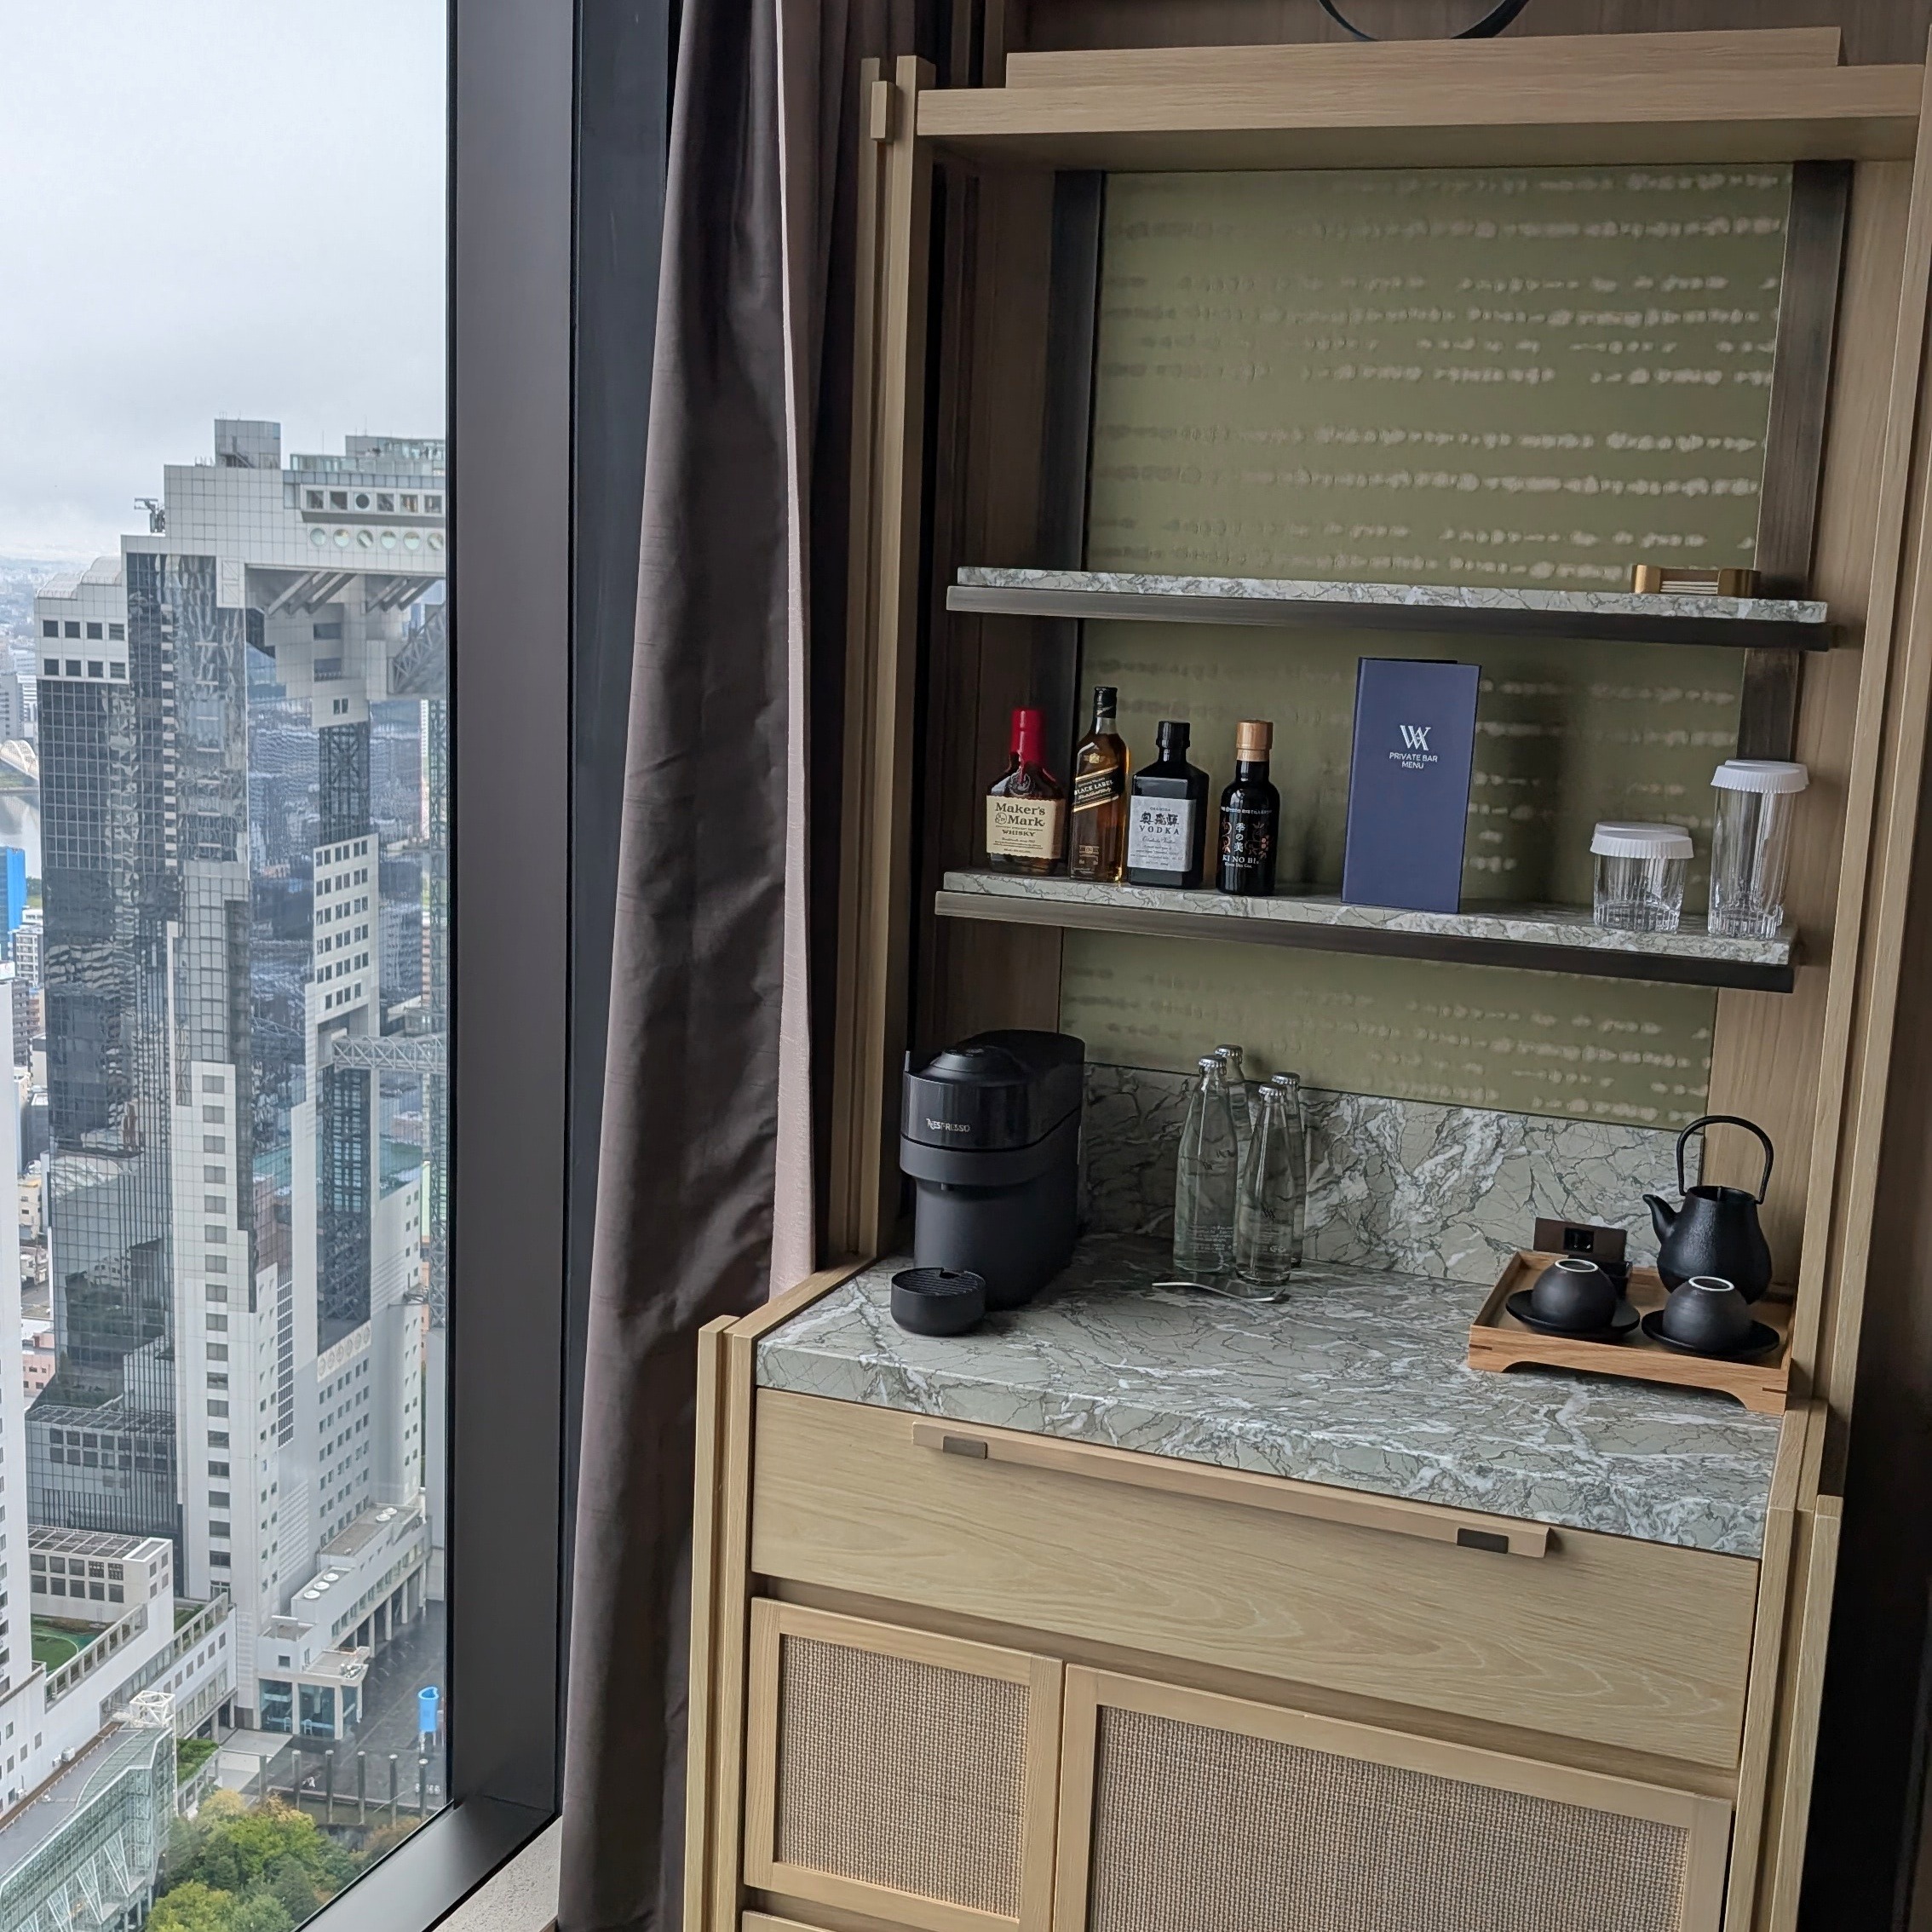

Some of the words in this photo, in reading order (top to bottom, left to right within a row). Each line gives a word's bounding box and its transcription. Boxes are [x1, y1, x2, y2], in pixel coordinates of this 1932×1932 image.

[1389, 752, 1421, 762] PRIVATE
[1401, 761, 1424, 769] MENU
[1094, 779, 1113, 789] LABEL
[995, 802, 1046, 815] Maker's
[1008, 814, 1046, 826] Mark
[1139, 825, 1180, 835] VODKA
